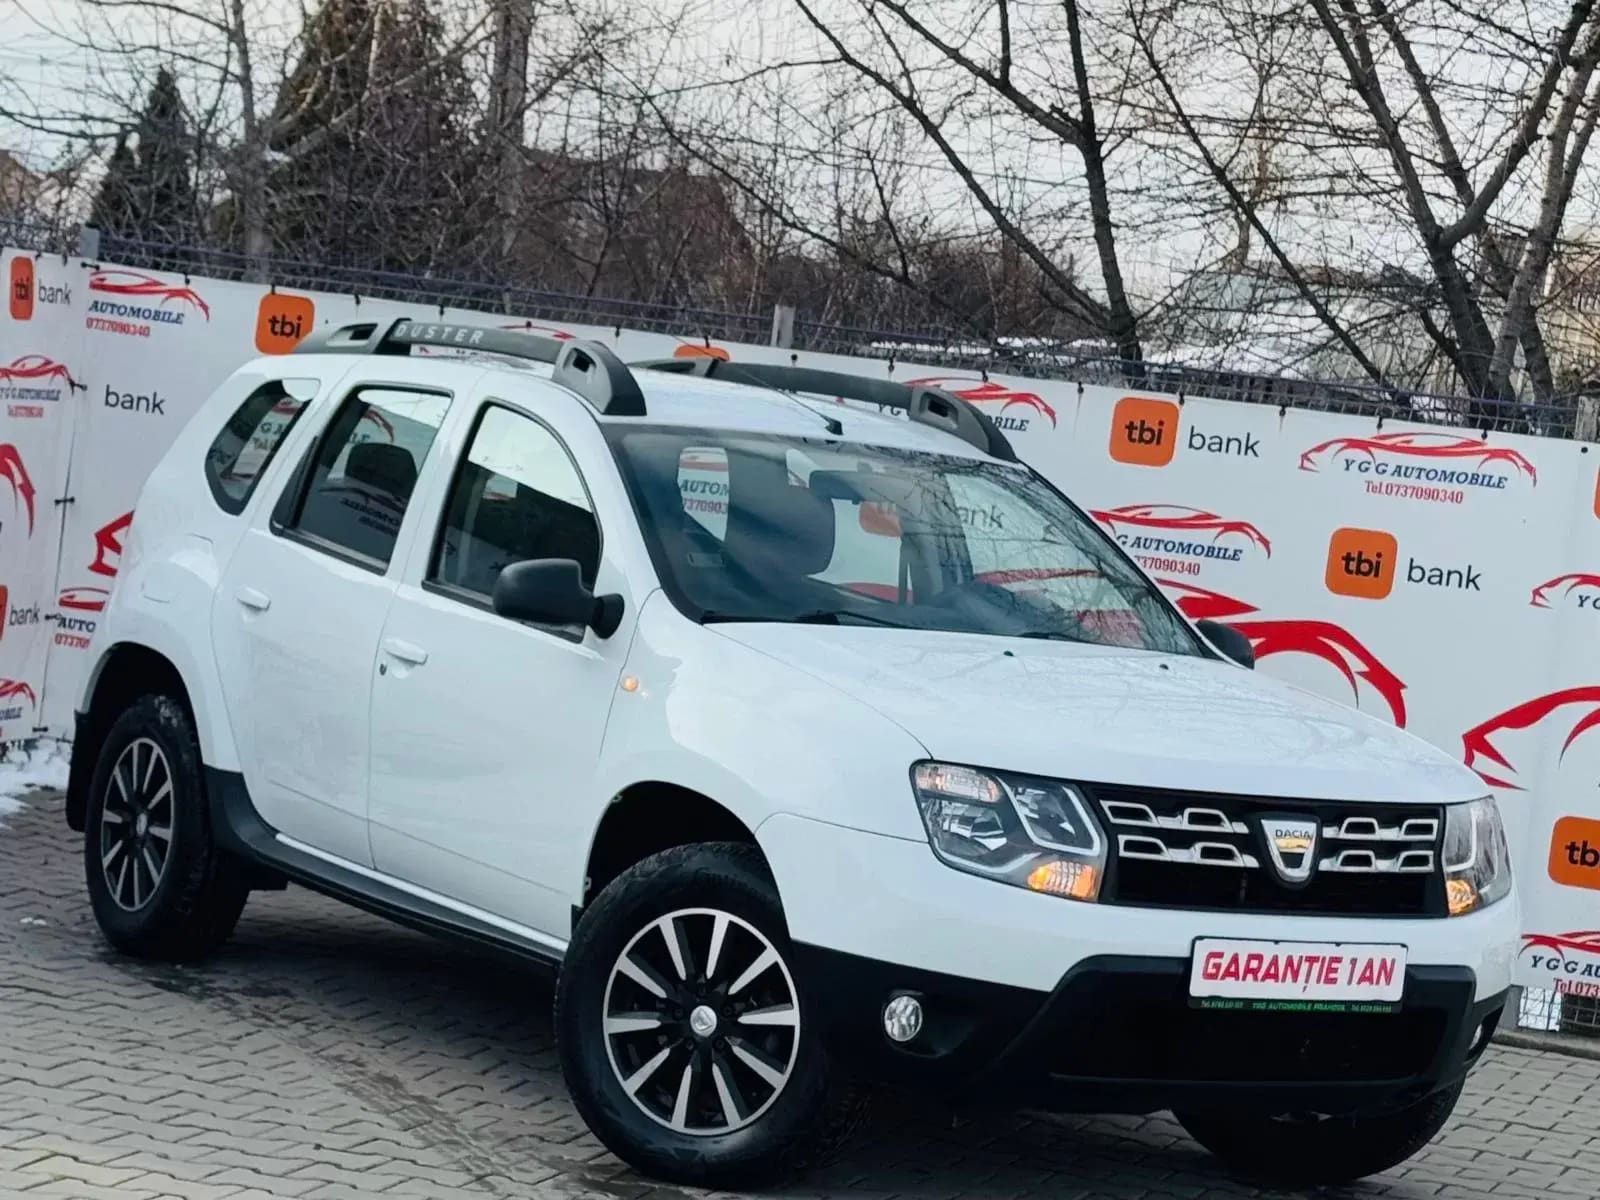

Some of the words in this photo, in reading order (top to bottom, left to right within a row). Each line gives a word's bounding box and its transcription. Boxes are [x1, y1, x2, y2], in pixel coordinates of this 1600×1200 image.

[38, 278, 72, 304] bank
[88, 299, 184, 324] AUTOMOBILE
[268, 313, 302, 339] tbi
[394, 322, 485, 344] DUSTER
[105, 384, 165, 415] bank
[1125, 419, 1165, 446] tbi
[1188, 425, 1261, 458] bank
[1391, 465, 1508, 489] AUTOMOBILE
[1130, 536, 1243, 561] AUTOMOBILE
[1341, 551, 1382, 578] tbi
[1407, 557, 1482, 591] bank
[9, 601, 40, 626] bank
[57, 617, 96, 633] AUTO
[1275, 829, 1310, 839] DACIA
